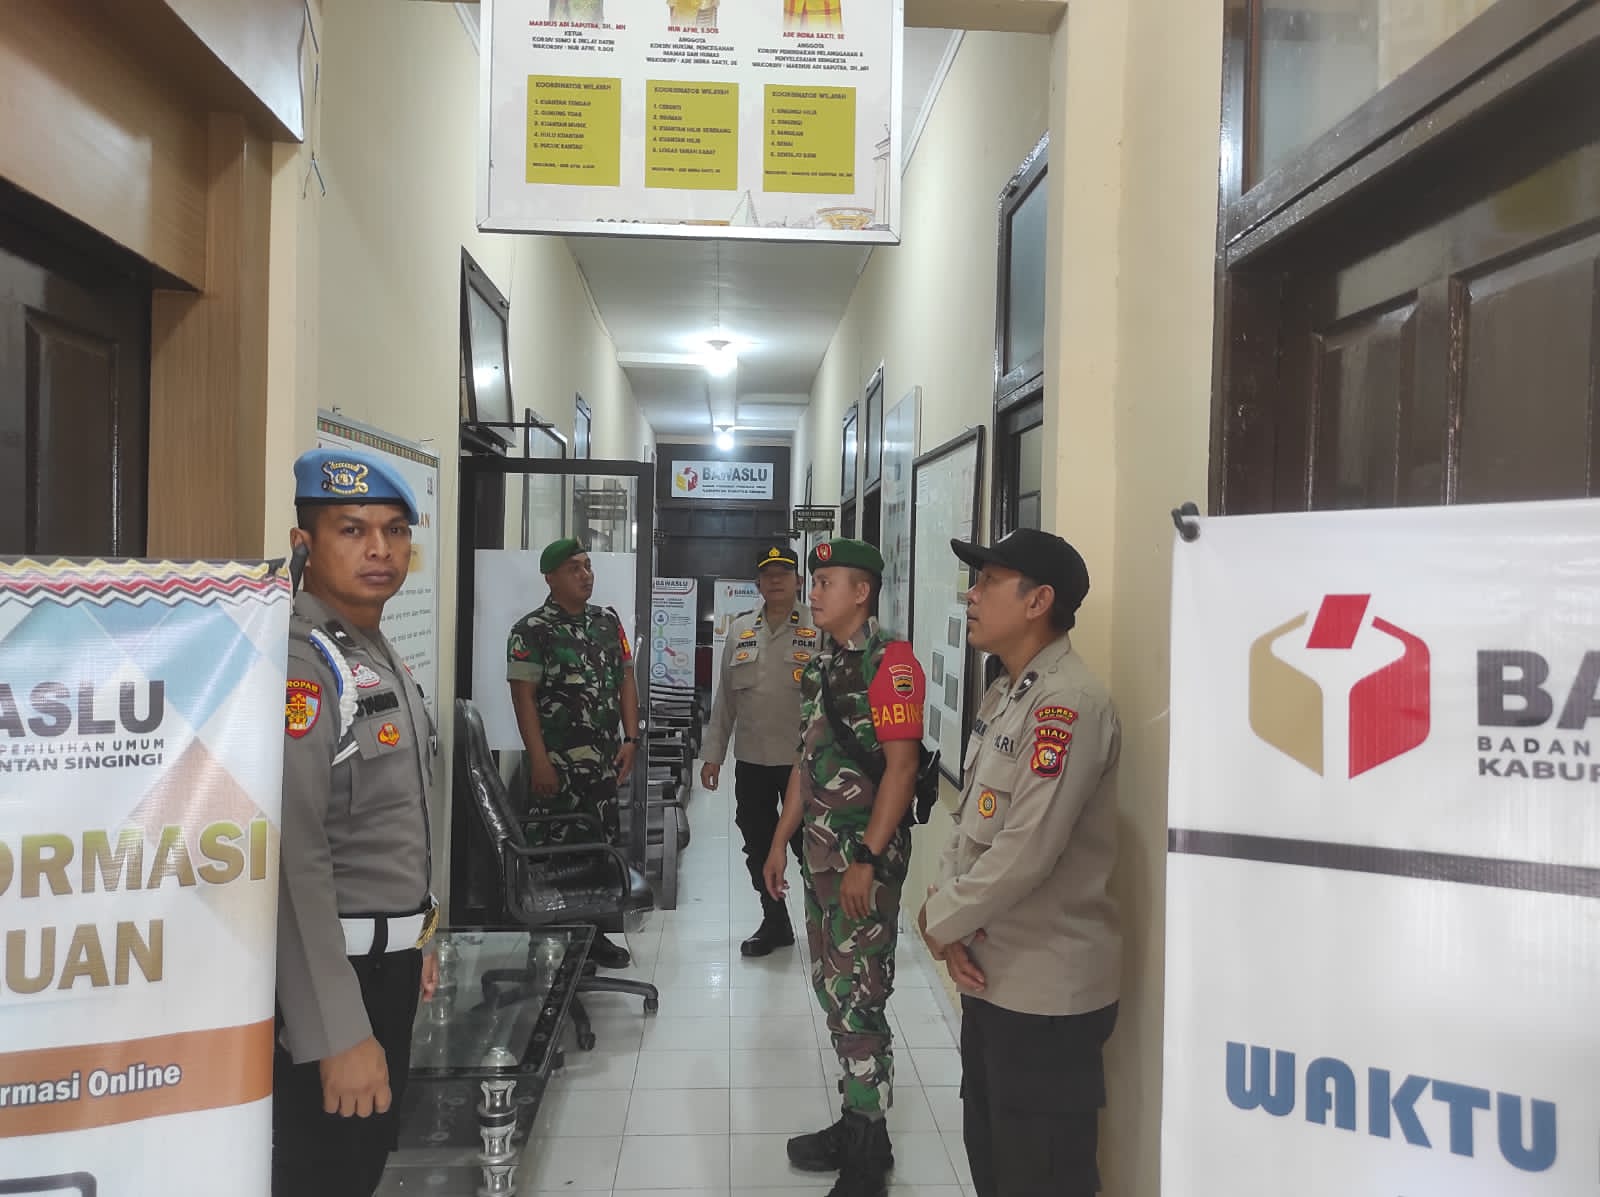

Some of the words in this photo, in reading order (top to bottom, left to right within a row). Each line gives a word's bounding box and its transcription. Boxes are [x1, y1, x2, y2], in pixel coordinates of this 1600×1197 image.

[702, 467, 768, 482] BAWASLU
[792, 640, 816, 648] POLRI
[1039, 708, 1073, 718] POLRES
[1040, 729, 1067, 739] RIAU
[113, 738, 164, 751] UMUM
[1477, 736, 1591, 756] BADAN
[64, 753, 162, 770] SINGINGI
[88, 1063, 182, 1098] Online
[1225, 1041, 1557, 1172] WAKTU
